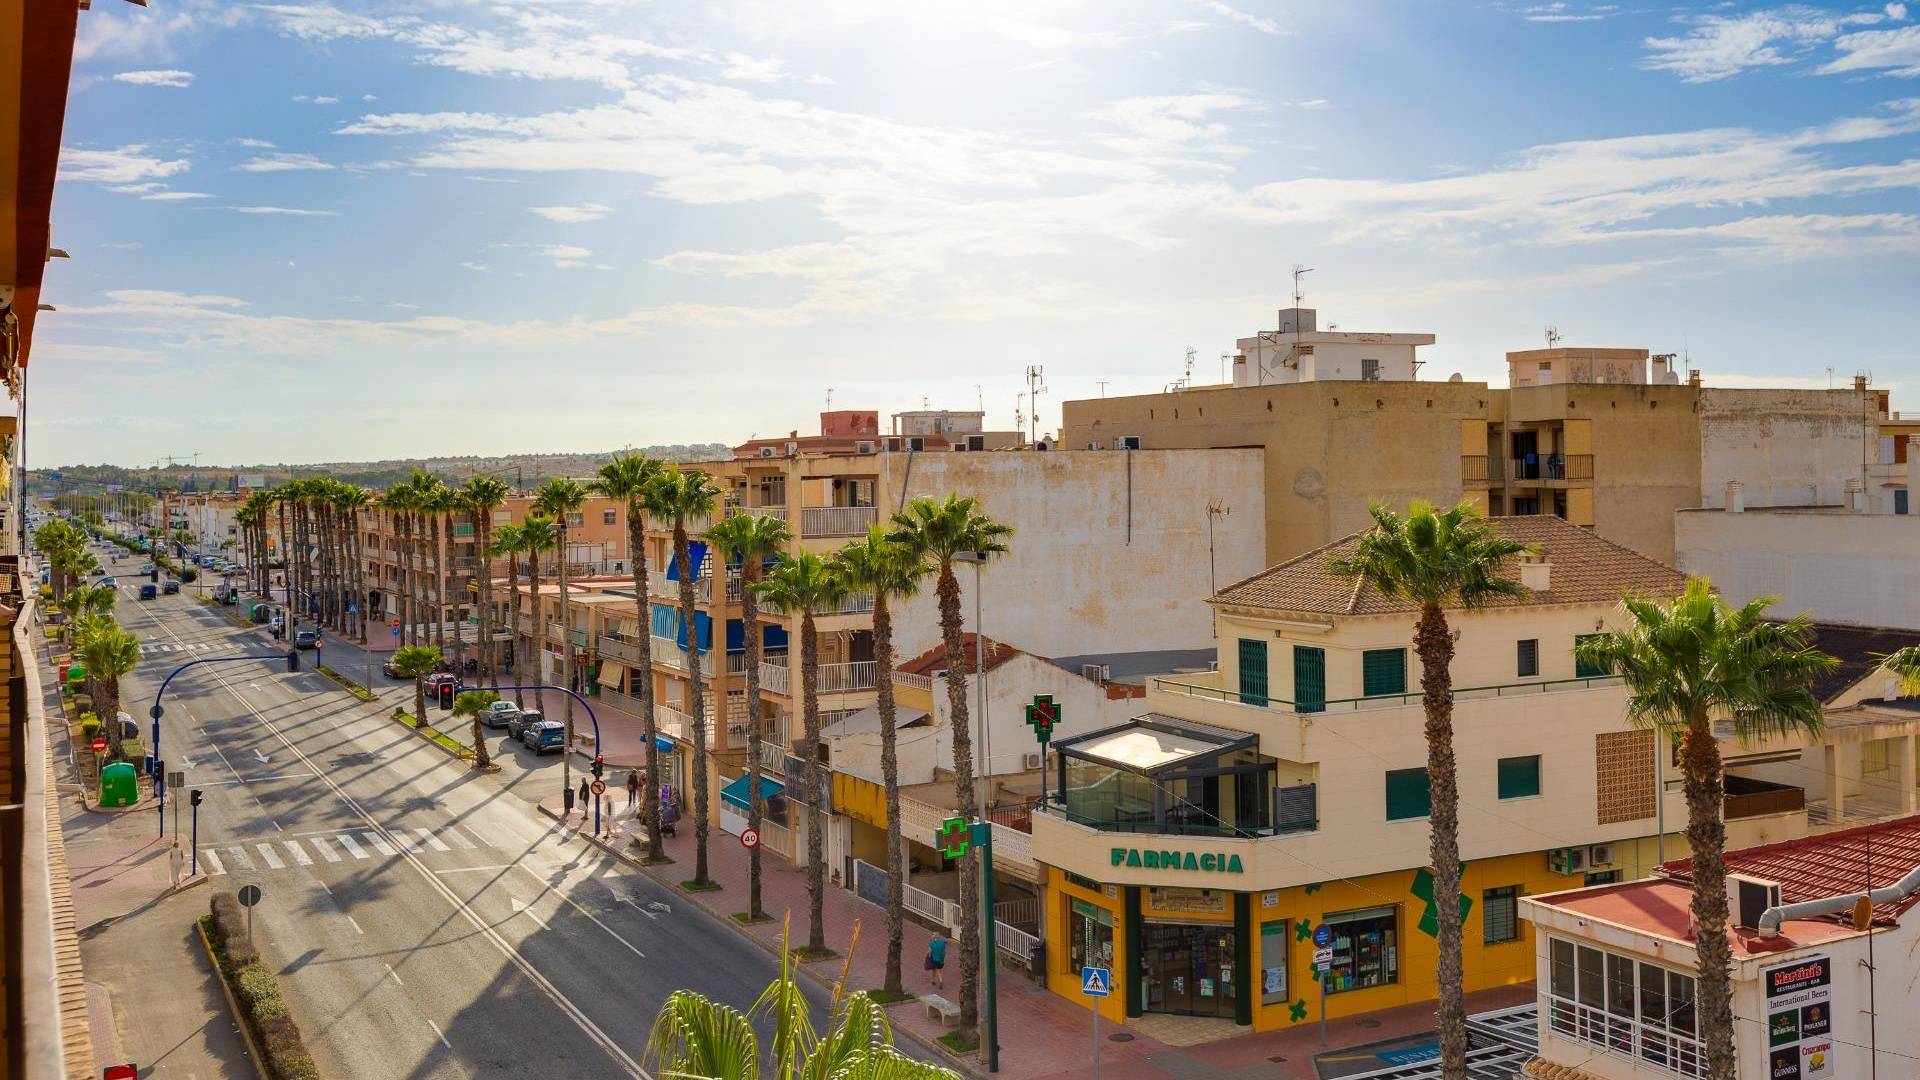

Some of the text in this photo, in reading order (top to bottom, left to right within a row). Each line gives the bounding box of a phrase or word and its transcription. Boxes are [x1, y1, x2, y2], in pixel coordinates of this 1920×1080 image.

[1111, 847, 1244, 873] FARMACIA
[1775, 963, 1822, 985] Martini's
[1769, 989, 1828, 1009] International Beers
[1801, 1043, 1831, 1056] Cruzcampo
[1774, 1064, 1798, 1077] GUINNESS
